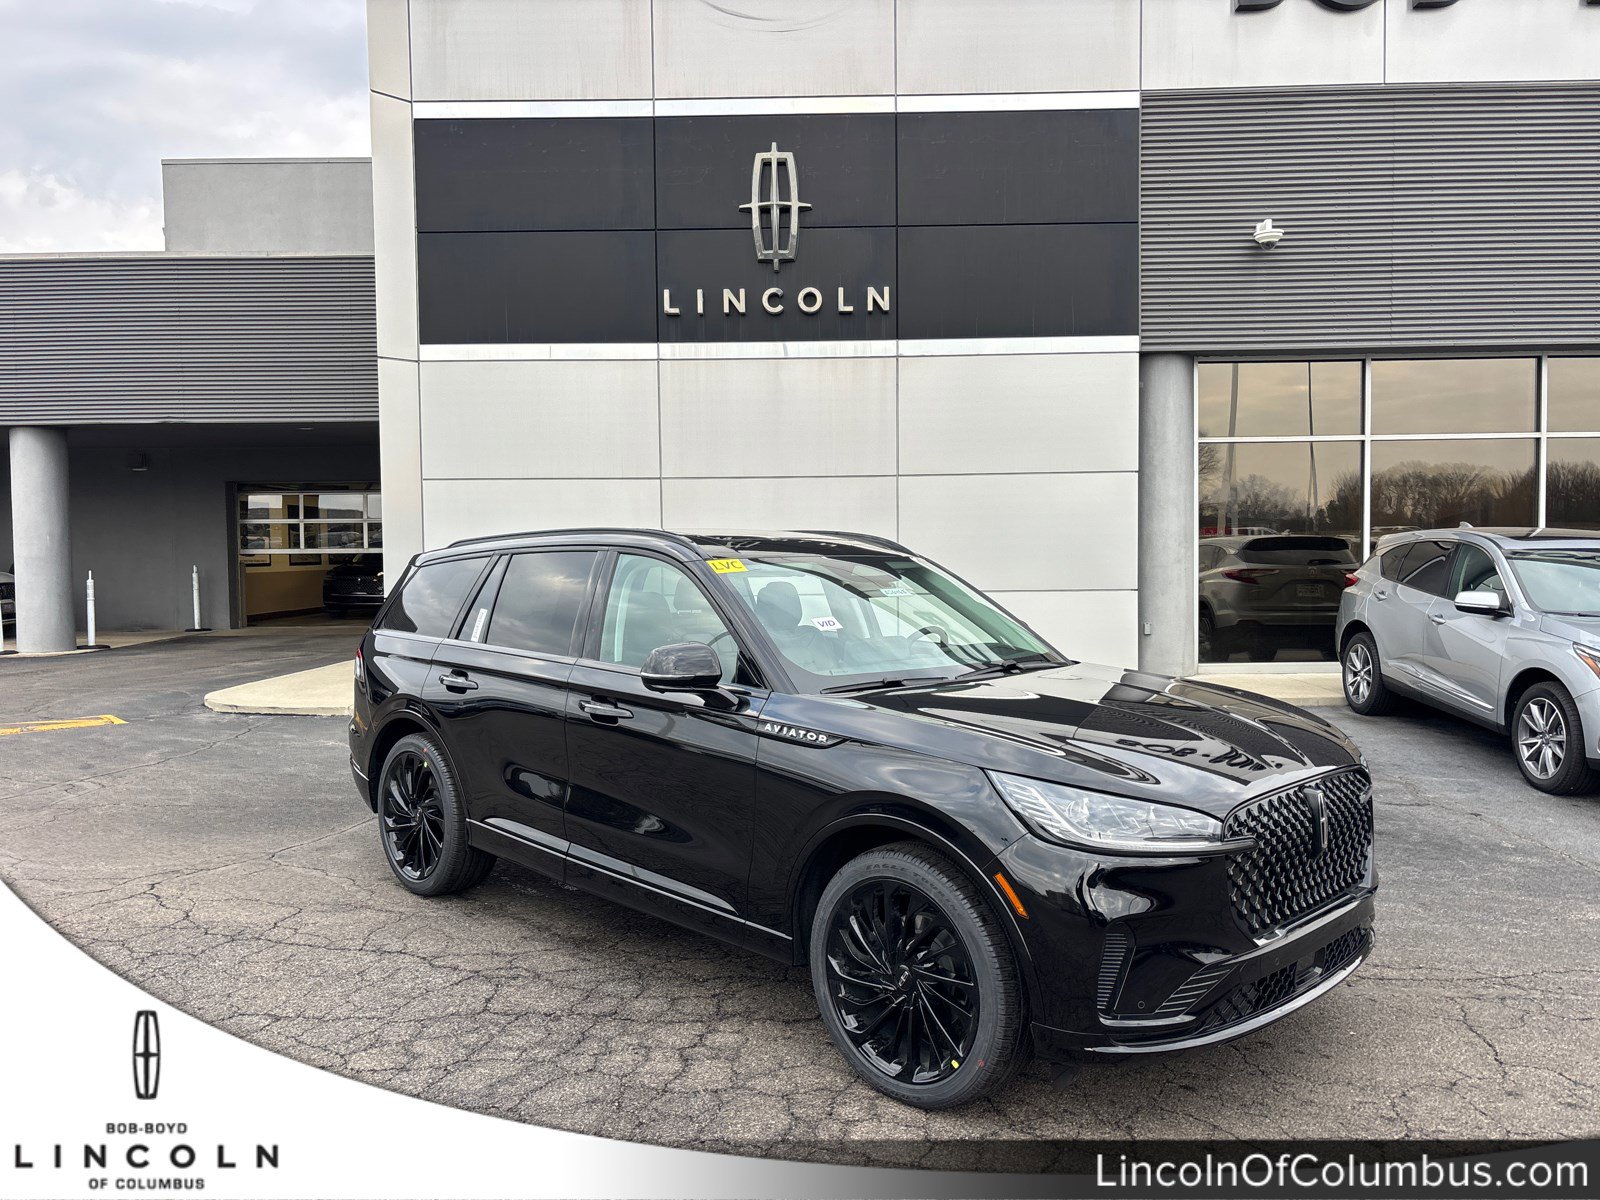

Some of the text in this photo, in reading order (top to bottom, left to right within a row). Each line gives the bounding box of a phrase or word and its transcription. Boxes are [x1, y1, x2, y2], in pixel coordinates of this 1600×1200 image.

[663, 286, 890, 315] LINCOLN
[712, 560, 743, 571] LVC
[816, 619, 836, 628] VID
[764, 723, 828, 743] AVIATOR
